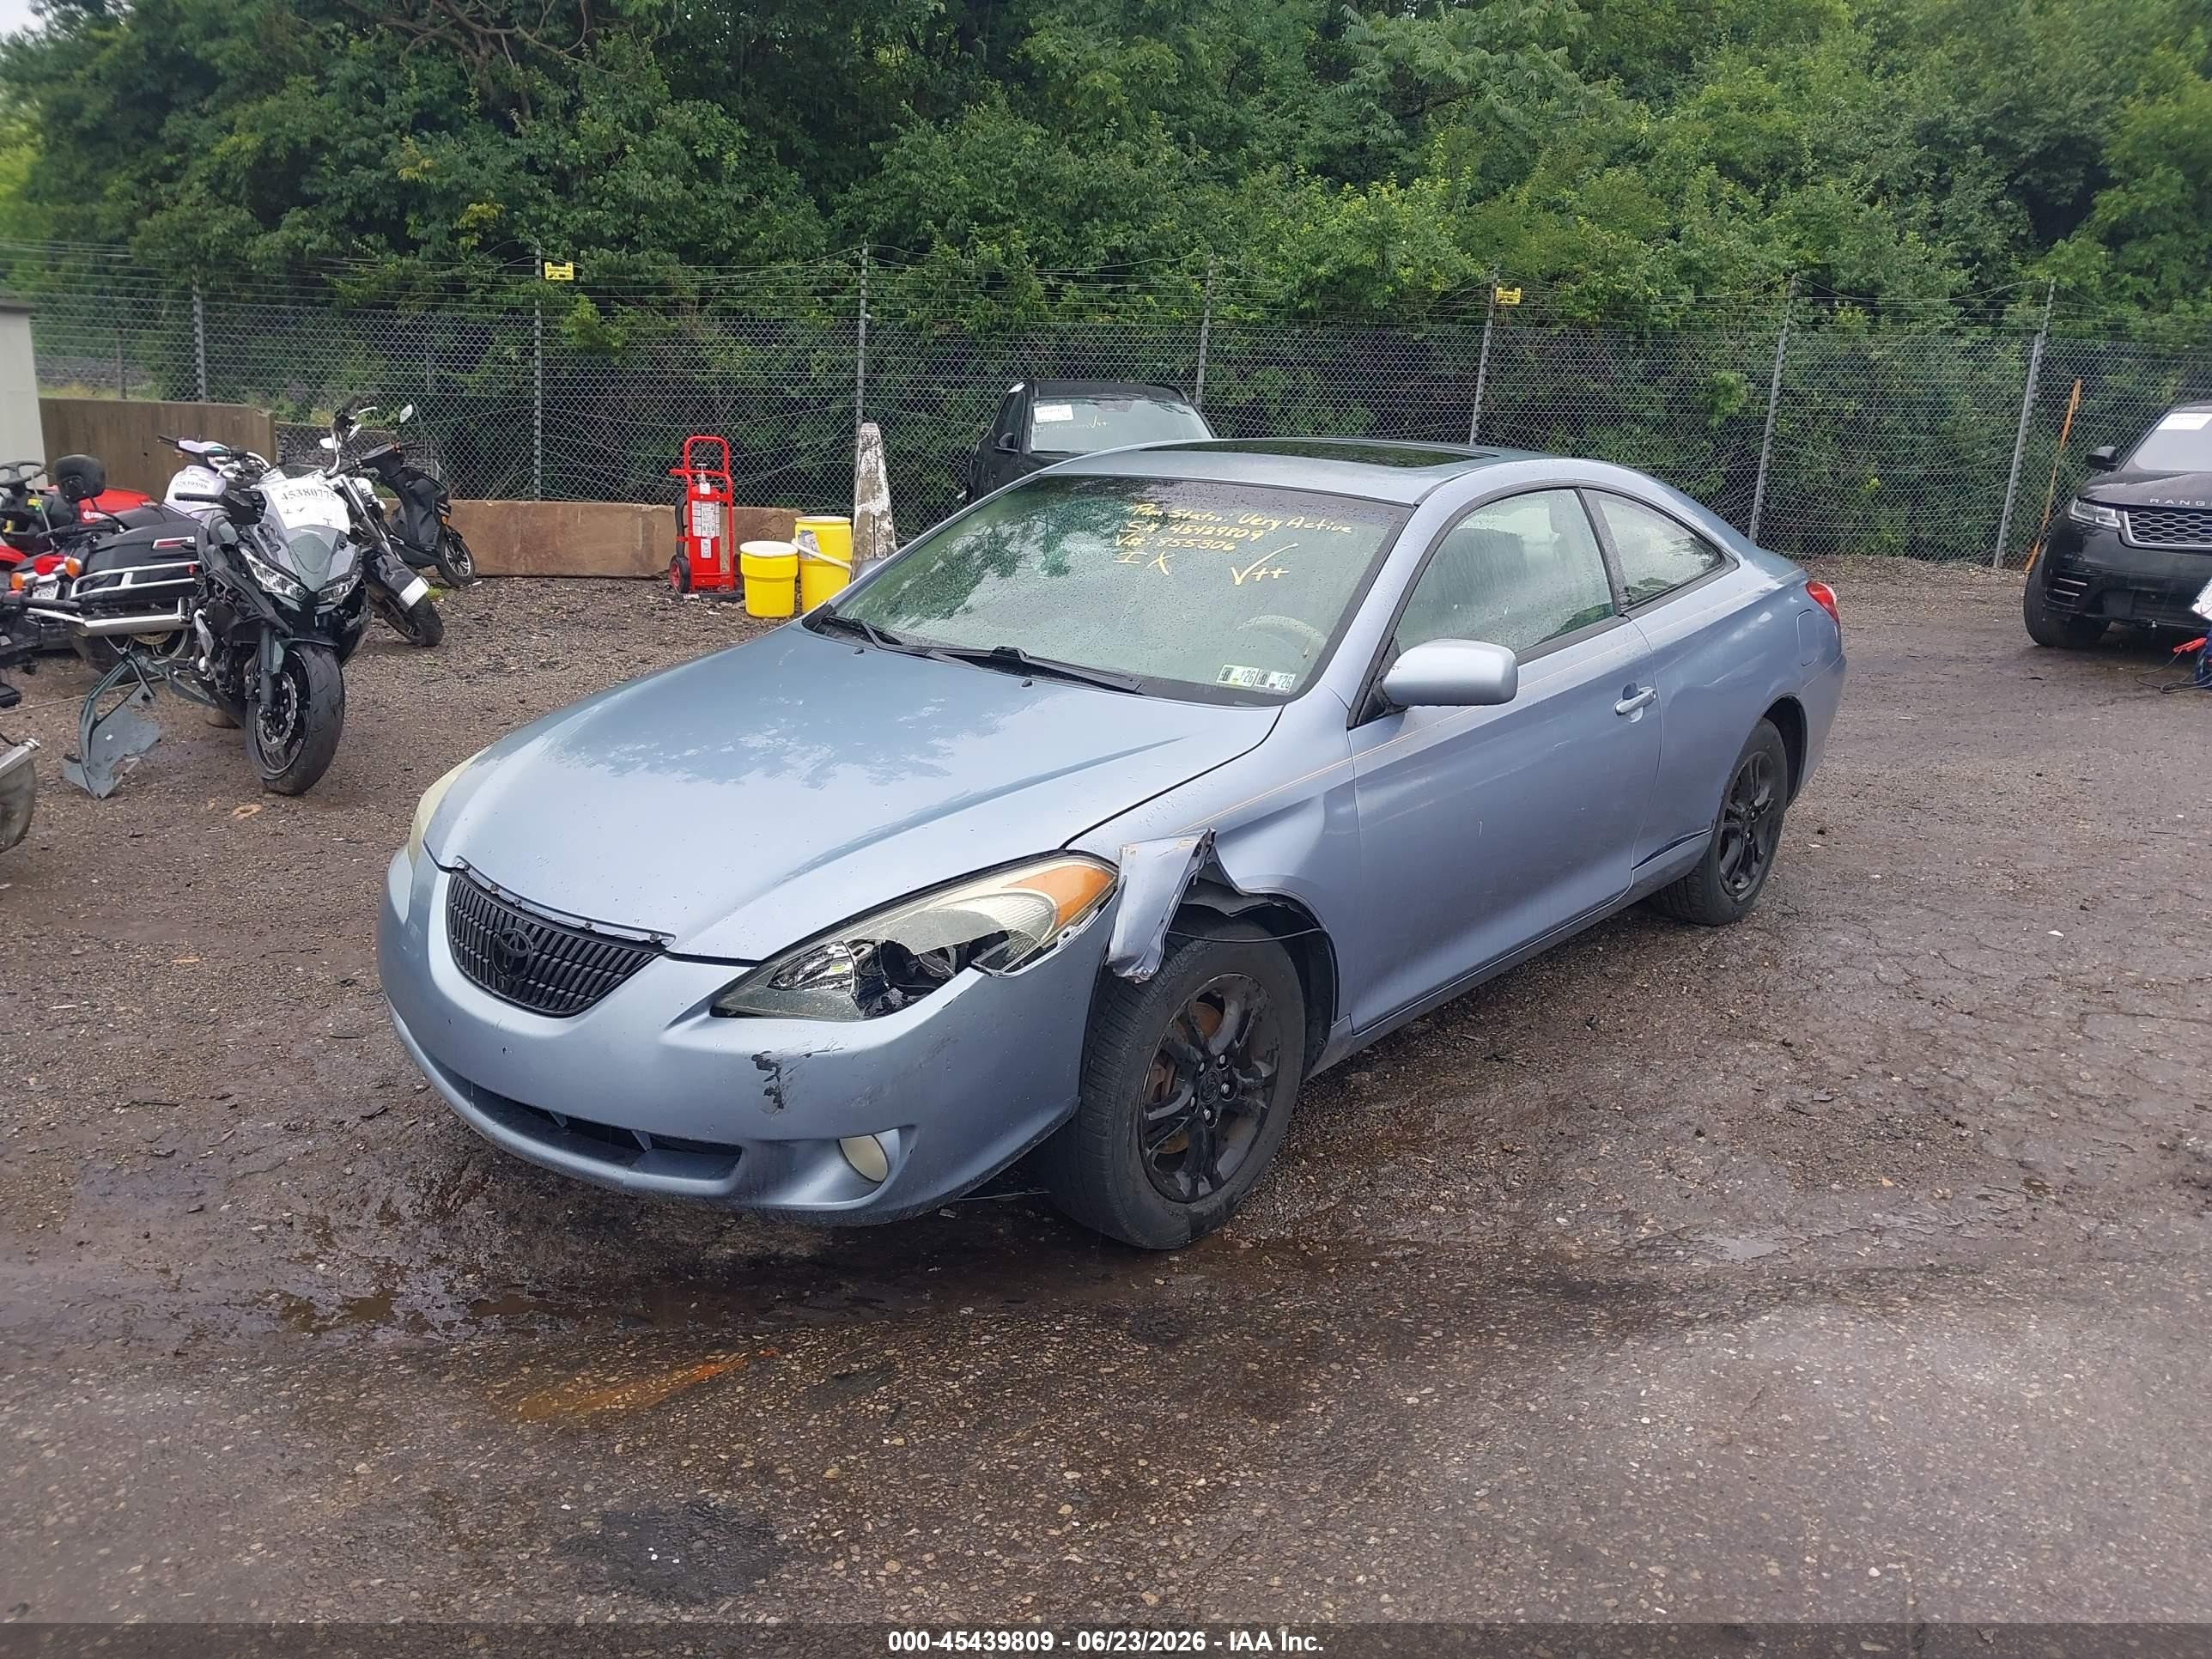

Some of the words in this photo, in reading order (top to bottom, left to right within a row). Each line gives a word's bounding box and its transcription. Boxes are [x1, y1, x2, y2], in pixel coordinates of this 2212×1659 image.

[2149, 498, 2212, 507] RANG
[1237, 513, 1284, 531] Very
[1285, 516, 1354, 533] Active
[1156, 537, 1237, 551] 855306
[1260, 673, 1267, 685] 8
